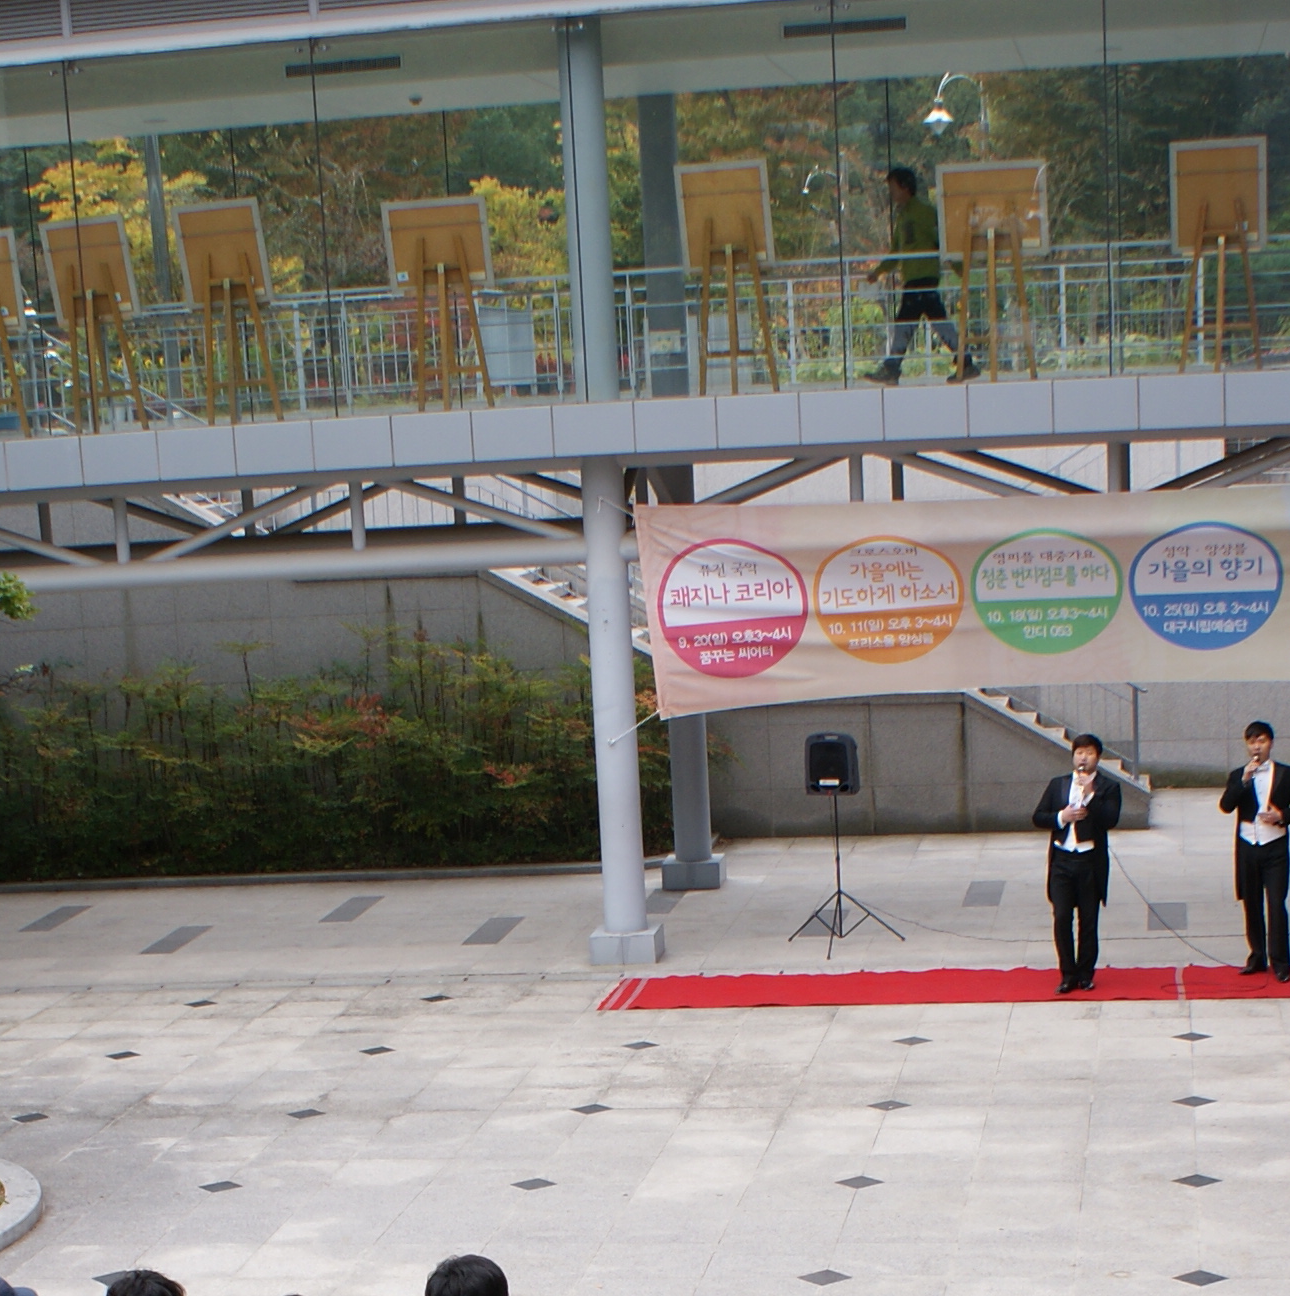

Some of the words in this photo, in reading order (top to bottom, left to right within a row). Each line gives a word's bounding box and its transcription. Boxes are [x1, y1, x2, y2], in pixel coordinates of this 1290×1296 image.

[1204, 542, 1248, 557] 앙상블
[849, 560, 924, 583] 가을에는
[981, 566, 1008, 590] 청춘
[1011, 564, 1078, 589] 번지점프를
[1080, 563, 1111, 583] 하다
[1148, 557, 1211, 583] 가을의
[1219, 556, 1263, 581] 향기
[734, 577, 793, 602] 코리아
[822, 583, 896, 609] 기도하게
[900, 580, 956, 602] 하소서
[987, 610, 1005, 624] 10.
[1142, 604, 1160, 617] 10.
[1164, 602, 1199, 617] 25(일)
[1202, 601, 1227, 615] 오후
[828, 623, 846, 635] 10.
[888, 616, 912, 630] 오후
[1163, 618, 1249, 635] 대구시립예술단
[700, 649, 735, 666] 꿈꾸는
[738, 645, 774, 661] 씨어터
